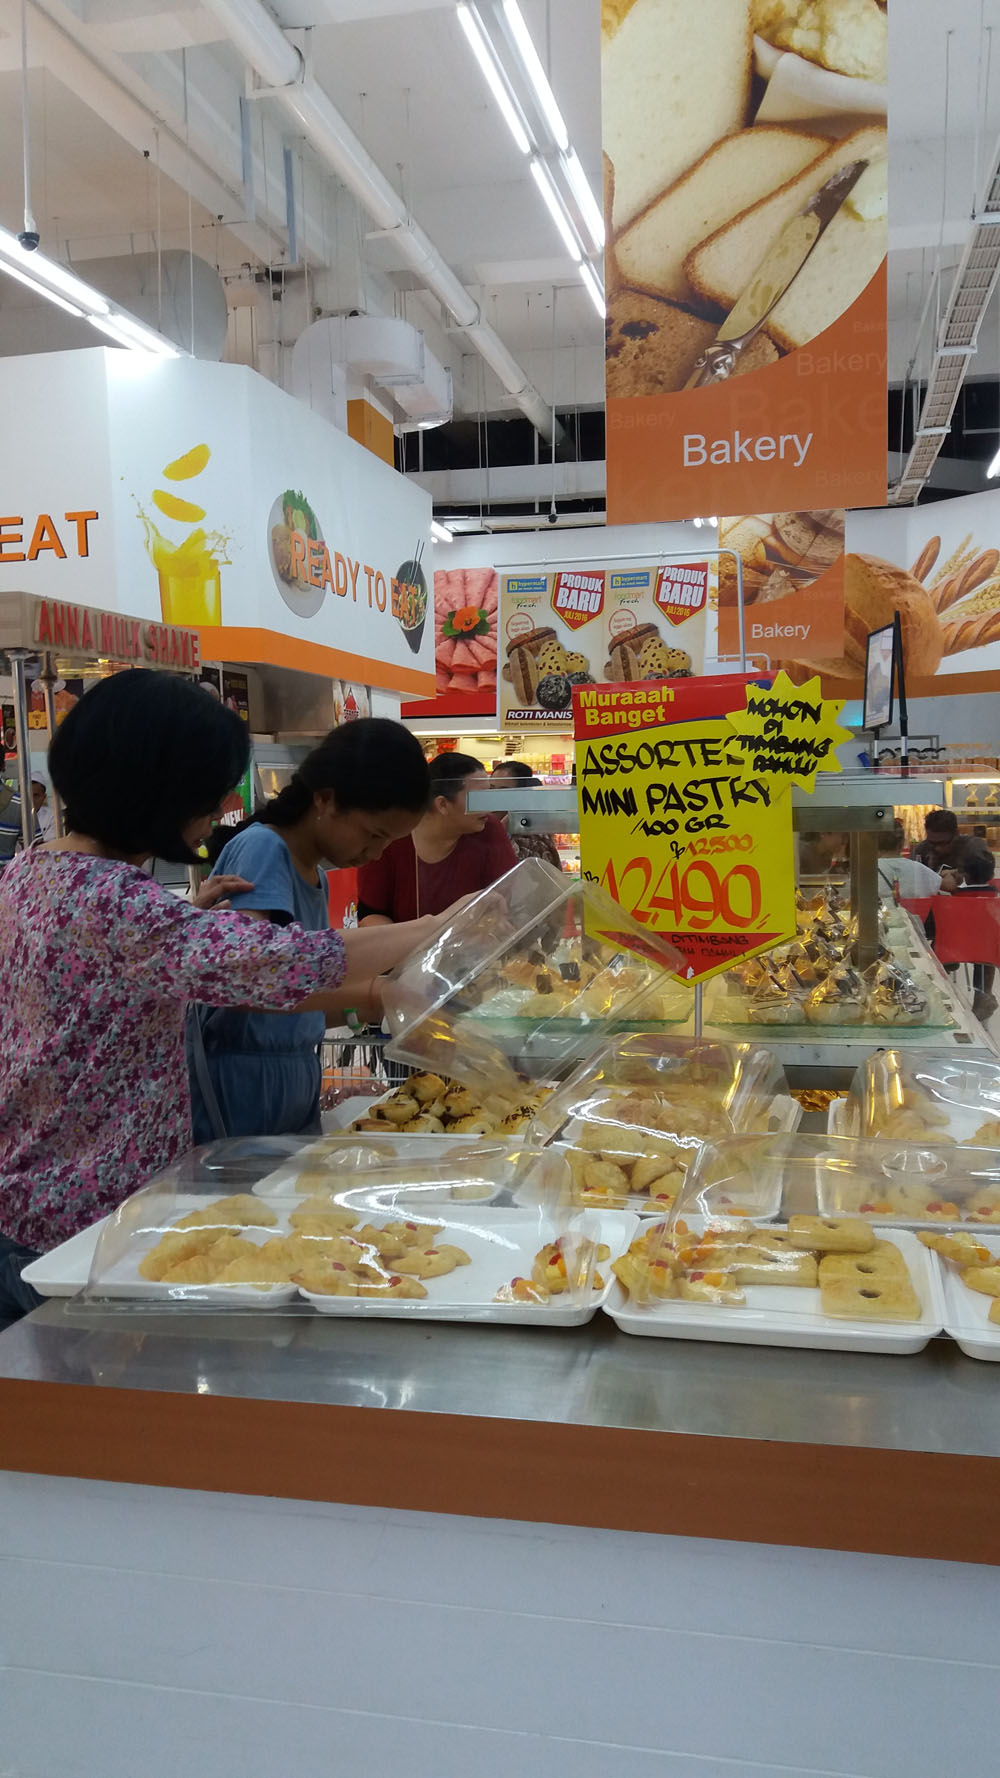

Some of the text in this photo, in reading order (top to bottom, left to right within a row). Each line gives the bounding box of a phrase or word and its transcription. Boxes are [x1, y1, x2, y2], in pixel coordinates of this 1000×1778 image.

[683, 431, 813, 467] Bakery
[0, 510, 98, 562] EAT
[291, 531, 418, 623] READY TO EAT
[560, 573, 604, 592] PRODUK
[663, 567, 706, 585] PRODUK
[556, 587, 602, 613] BARU
[659, 581, 705, 607] BARU
[563, 610, 573, 620] JULI
[665, 605, 676, 614] JULI
[39, 600, 200, 668] ANNA MILK SHAKE
[752, 623, 811, 640] Bakery
[579, 686, 675, 708] Muraaah
[507, 710, 573, 719] ROTI MANIS
[585, 705, 666, 728] Banget
[747, 698, 822, 725] MOHON
[763, 718, 783, 736] DI
[581, 785, 638, 817] MINI
[685, 814, 730, 833] GR
